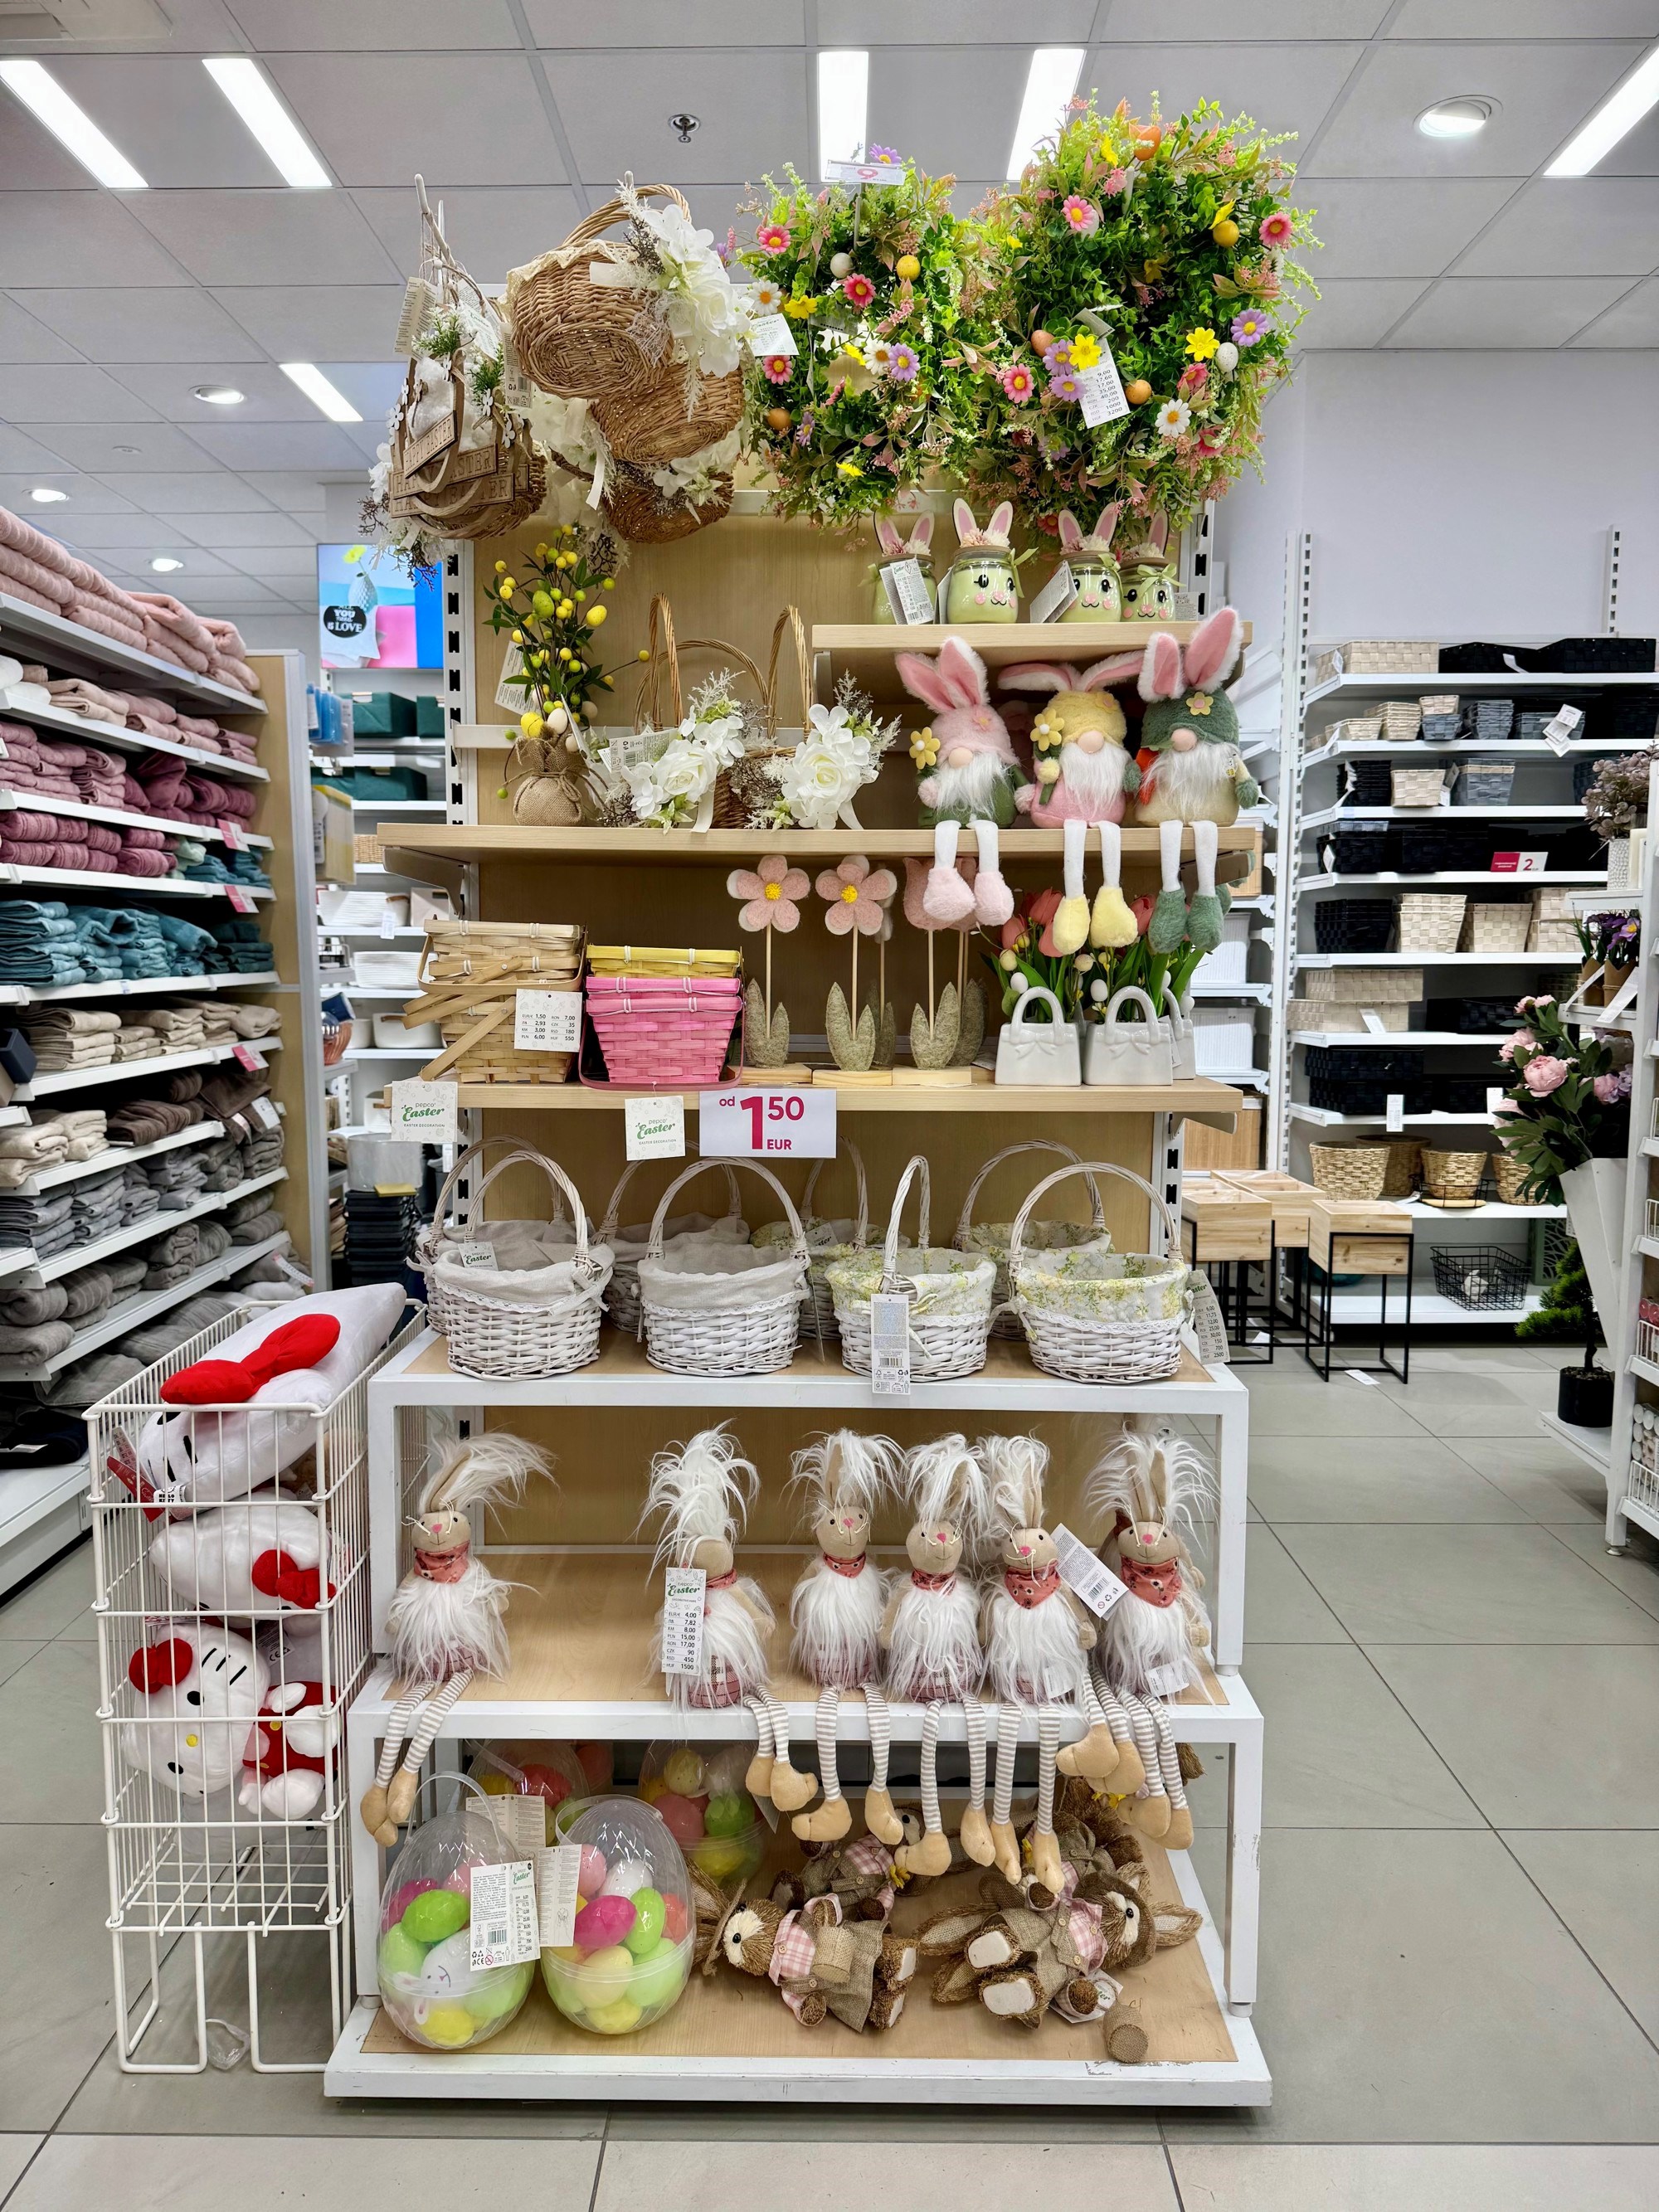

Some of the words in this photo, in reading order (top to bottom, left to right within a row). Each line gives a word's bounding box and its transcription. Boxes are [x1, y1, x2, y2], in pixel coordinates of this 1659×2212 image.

[1096, 375, 1112, 383] 17,60
[1097, 380, 1114, 388] 17,00
[1099, 386, 1116, 394] 35,00
[1100, 391, 1117, 399] 40,00
[1107, 401, 1121, 410] 1000
[1107, 407, 1123, 416] 3200
[333, 610, 356, 618] YOU
[335, 622, 362, 632] LOVE
[1523, 858, 1533, 871] 2
[401, 1106, 445, 1121] Easter
[718, 1096, 735, 1106] od
[740, 1096, 763, 1150] 1
[767, 1096, 805, 1121] 50
[636, 1123, 675, 1140] Easter
[766, 1139, 792, 1150] EUR
[465, 1256, 491, 1264] Easter
[667, 1584, 700, 1596] Easter
[513, 1873, 530, 1884] Easter
